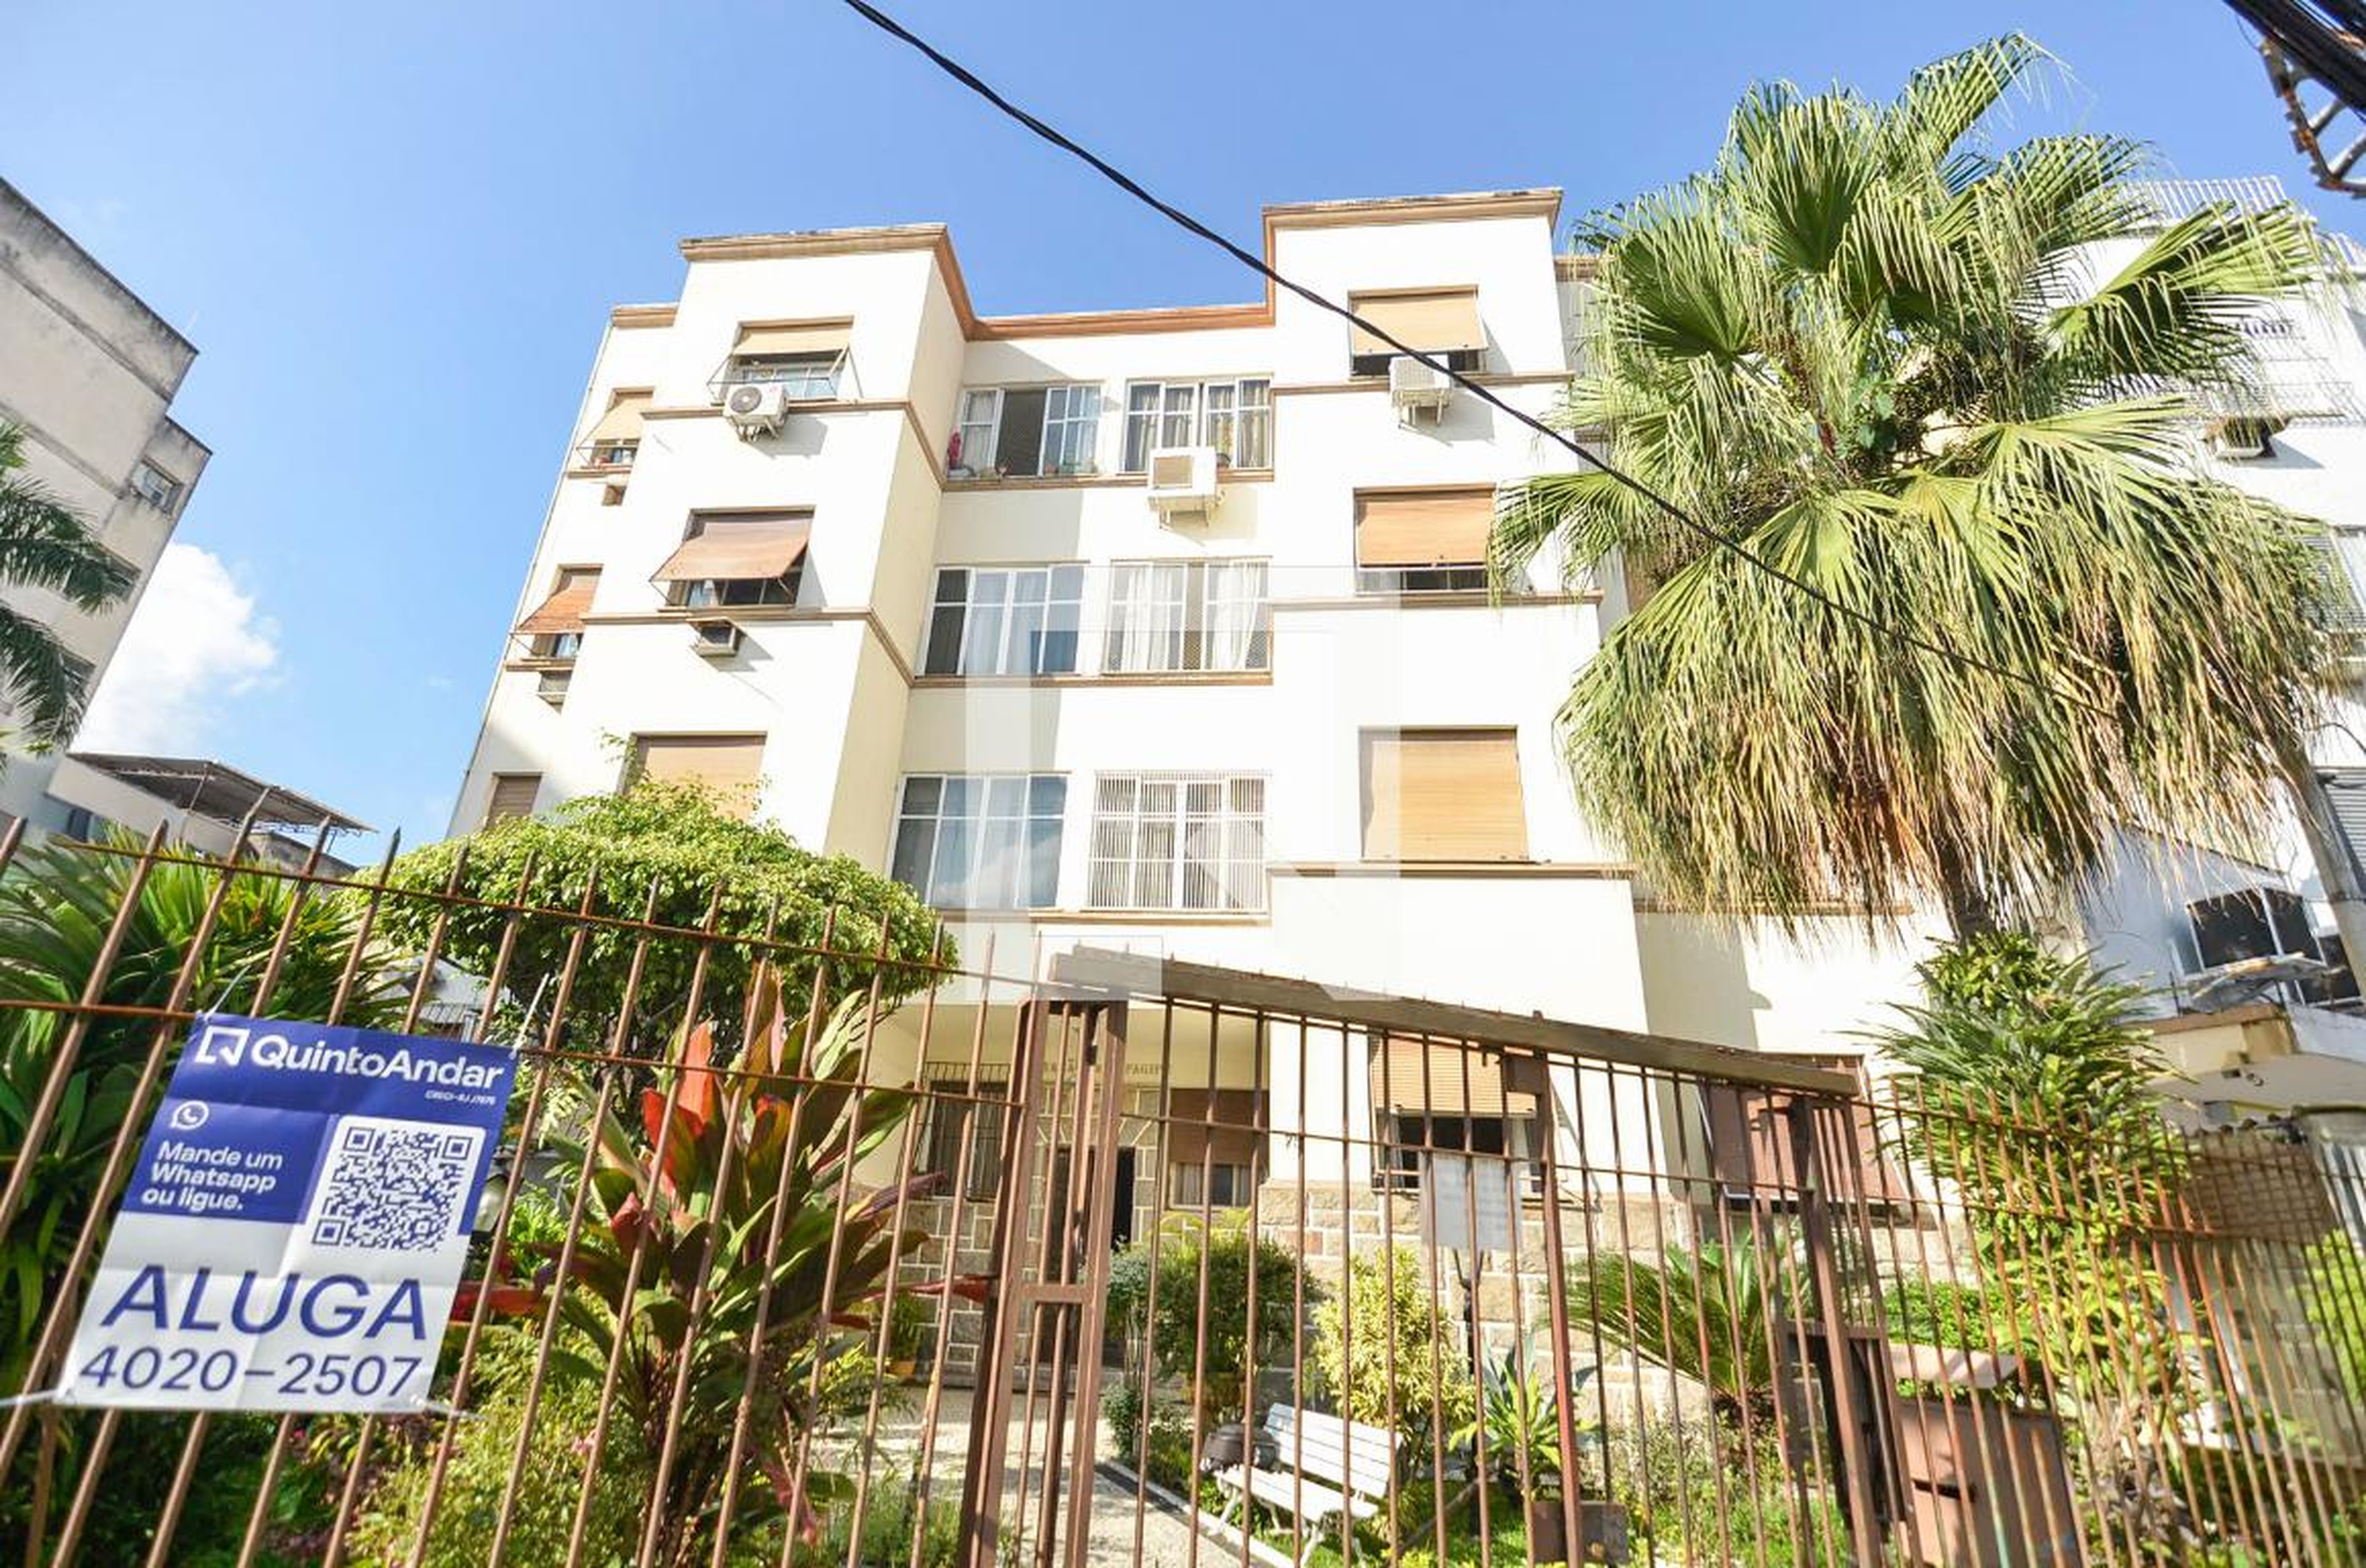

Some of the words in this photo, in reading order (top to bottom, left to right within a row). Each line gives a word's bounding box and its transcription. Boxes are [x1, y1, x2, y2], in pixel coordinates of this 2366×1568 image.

[251, 1034, 505, 1089] QuintoAndar
[157, 1140, 242, 1166] Mande
[245, 1152, 283, 1170] um
[141, 1188, 176, 1206] ou
[178, 1186, 244, 1213] ligue.
[150, 1162, 277, 1194] Whatsapp
[99, 1263, 427, 1341] ALUGA
[80, 1344, 423, 1398] 4020-2507
